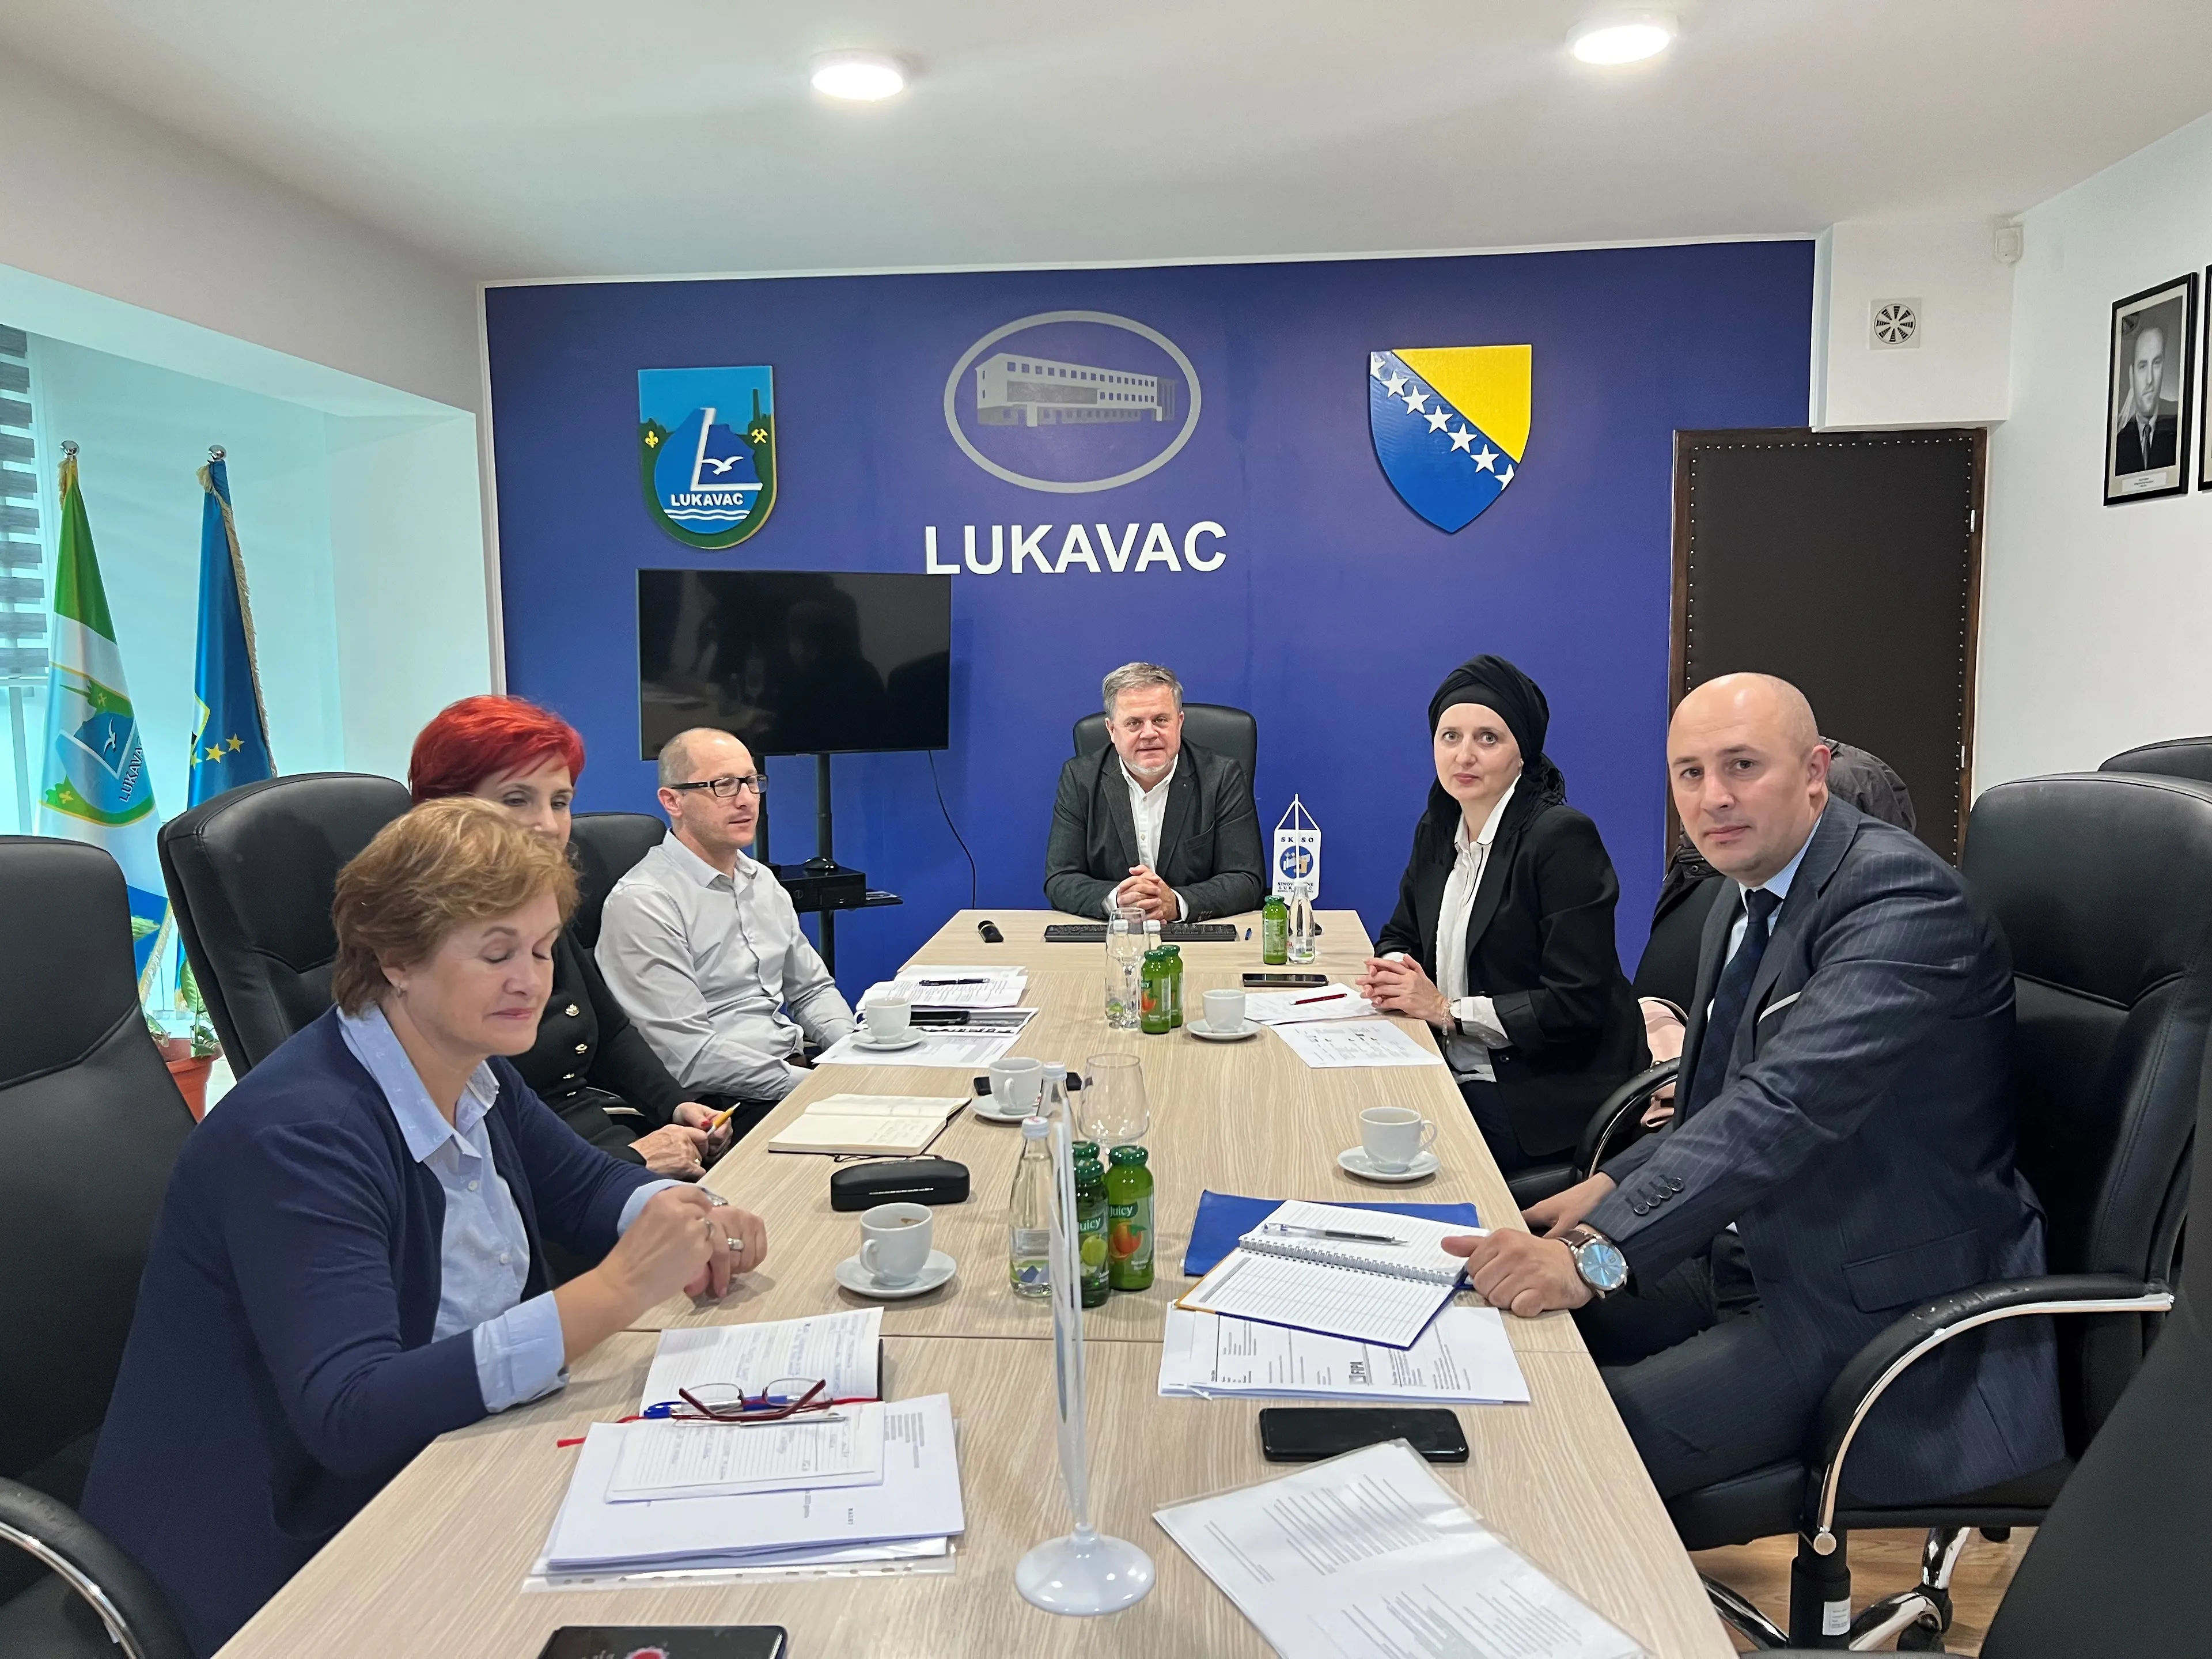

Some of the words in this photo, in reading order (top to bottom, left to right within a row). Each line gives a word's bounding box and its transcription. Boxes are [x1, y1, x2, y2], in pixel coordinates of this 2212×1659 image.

[671, 493, 744, 506] LUKAVAC
[925, 521, 1226, 574] LUKAVAC
[1080, 1217, 1101, 1232] uicy
